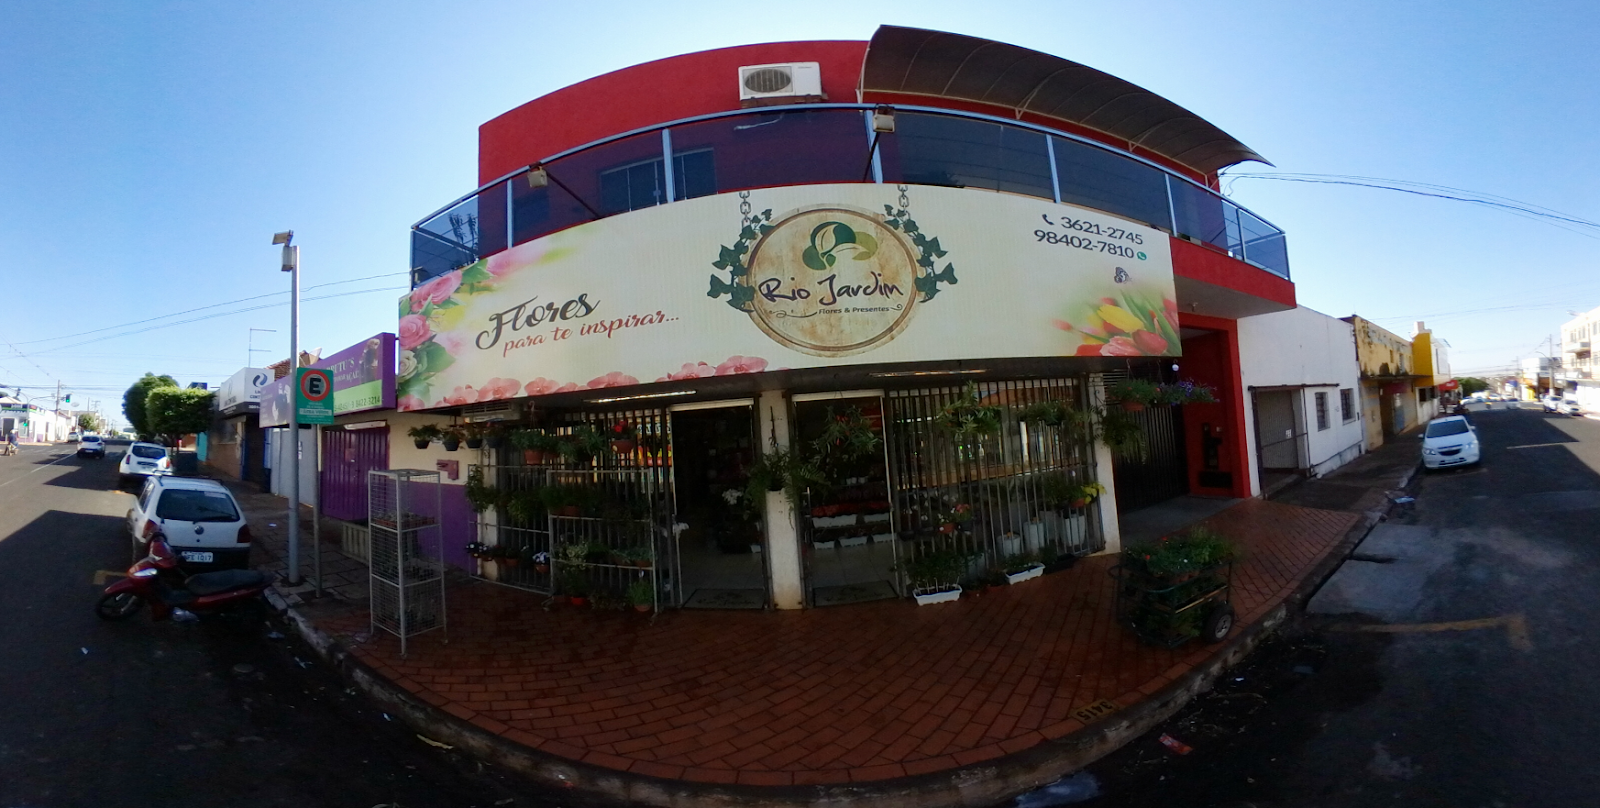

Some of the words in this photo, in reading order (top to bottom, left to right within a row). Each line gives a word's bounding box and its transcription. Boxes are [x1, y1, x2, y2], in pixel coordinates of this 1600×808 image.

[1033, 229, 1135, 259] 98402-7810
[1060, 216, 1143, 245] 3621-2745
[758, 277, 811, 303] Rio
[817, 271, 904, 306] Jardim
[475, 293, 601, 351] Flores
[818, 307, 843, 315] Flores
[852, 305, 890, 313] Presentes
[502, 333, 547, 359] para
[550, 326, 575, 342] te
[579, 310, 680, 339] inspirar...
[309, 377, 322, 395] E
